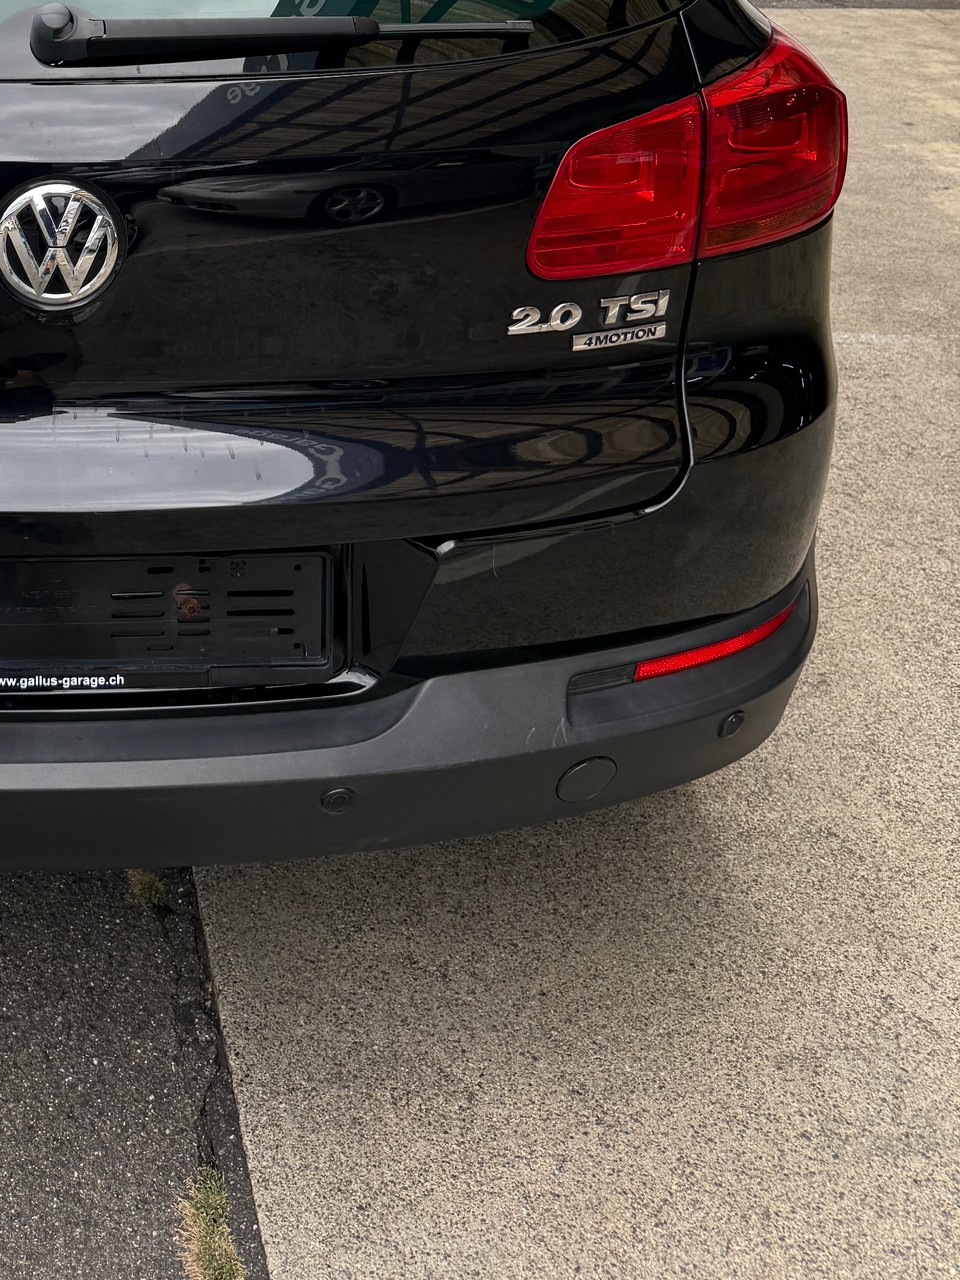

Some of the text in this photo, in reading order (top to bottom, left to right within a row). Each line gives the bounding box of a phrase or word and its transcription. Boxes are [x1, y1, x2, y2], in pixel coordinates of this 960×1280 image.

[507, 288, 671, 336] 2.0 TSI
[583, 327, 658, 348] 4MOTION
